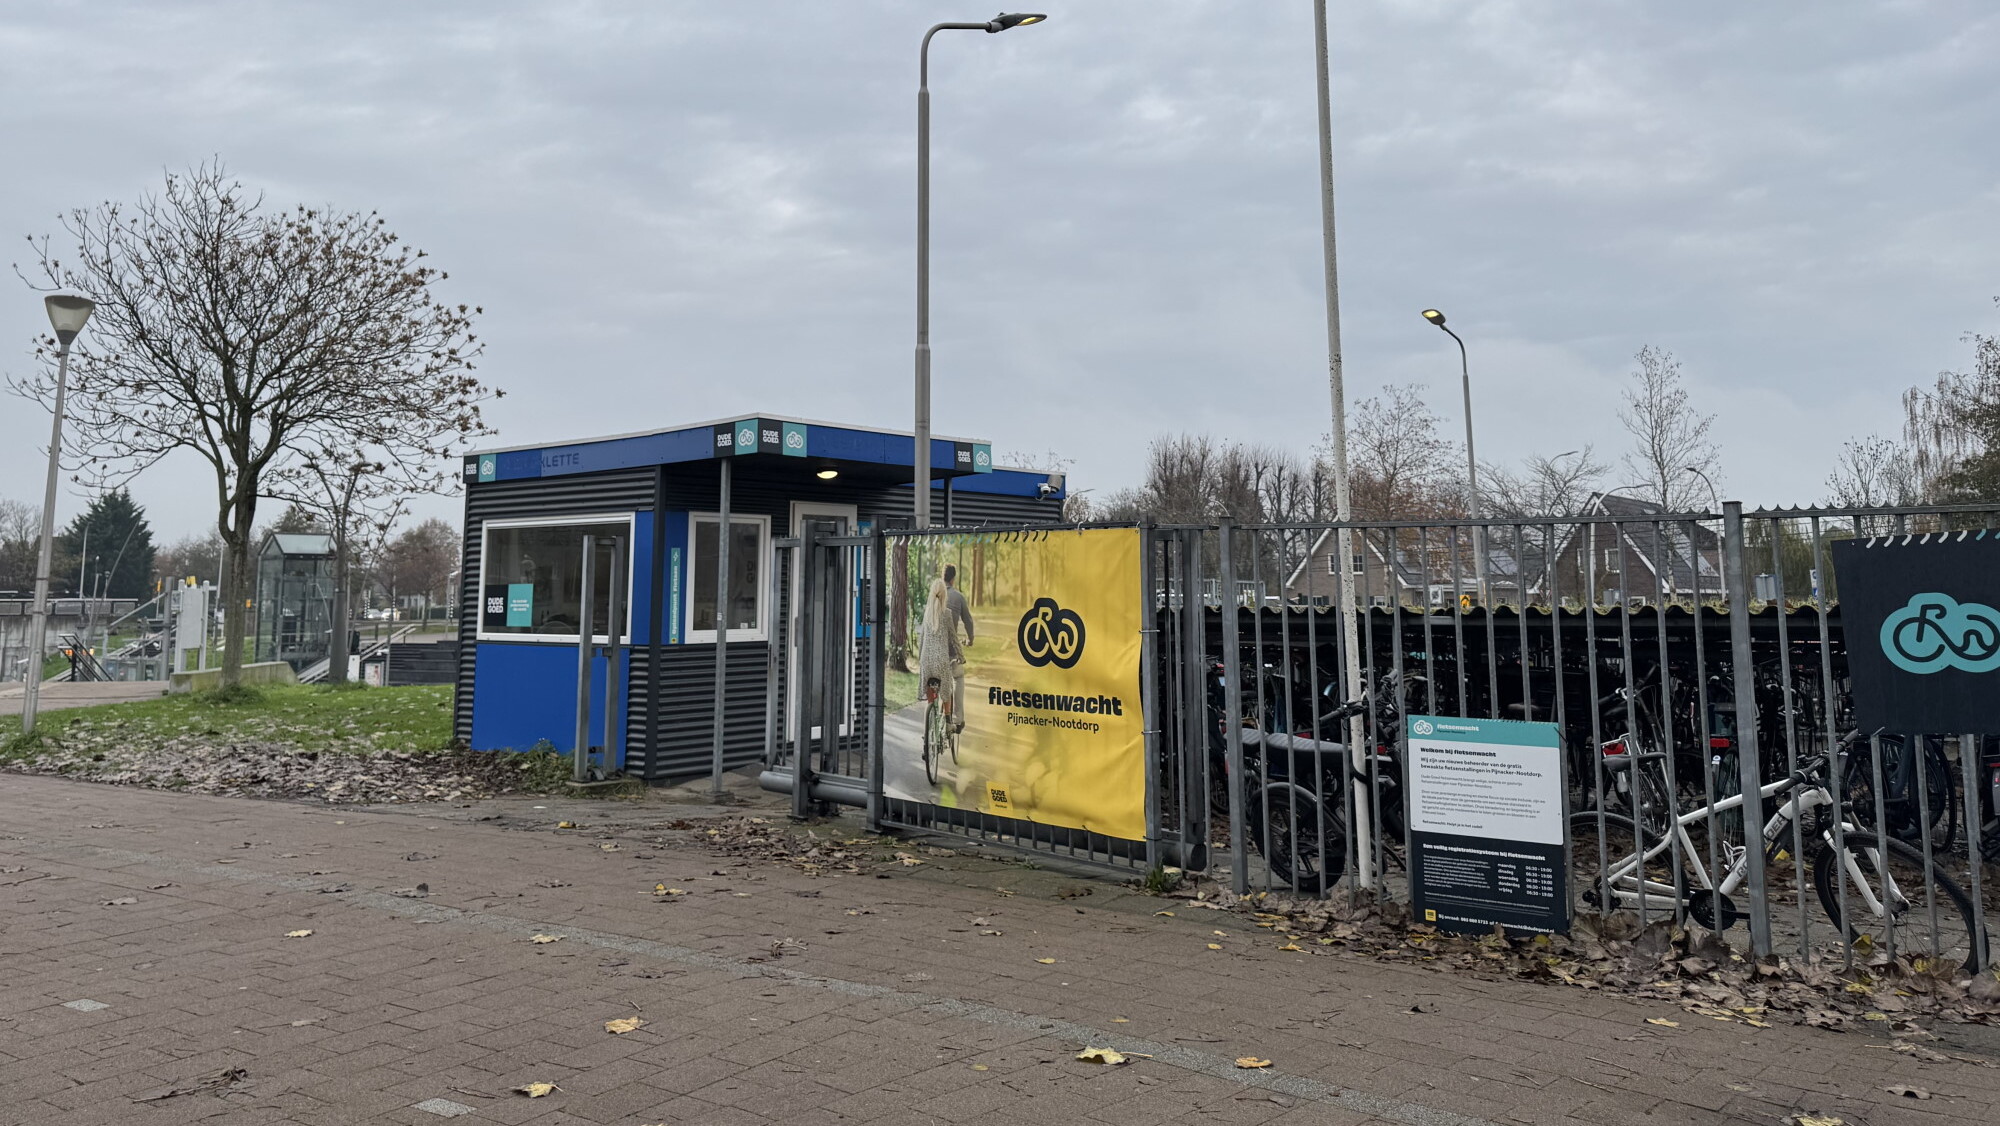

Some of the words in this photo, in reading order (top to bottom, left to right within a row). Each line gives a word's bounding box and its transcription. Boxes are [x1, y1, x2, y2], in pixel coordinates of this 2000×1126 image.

[717, 433, 732, 441] DUDE
[762, 429, 779, 438] DUDE
[487, 596, 504, 606] DUDE
[988, 686, 1123, 716] fietsenwacht
[1007, 712, 1100, 734] Pijnacker-Nootdorp
[1437, 723, 1479, 732] fietsenwacht
[1454, 749, 1497, 757] fietsenwacht
[990, 788, 1006, 797] DUDE
[1508, 852, 1546, 861] fietsenwacht
